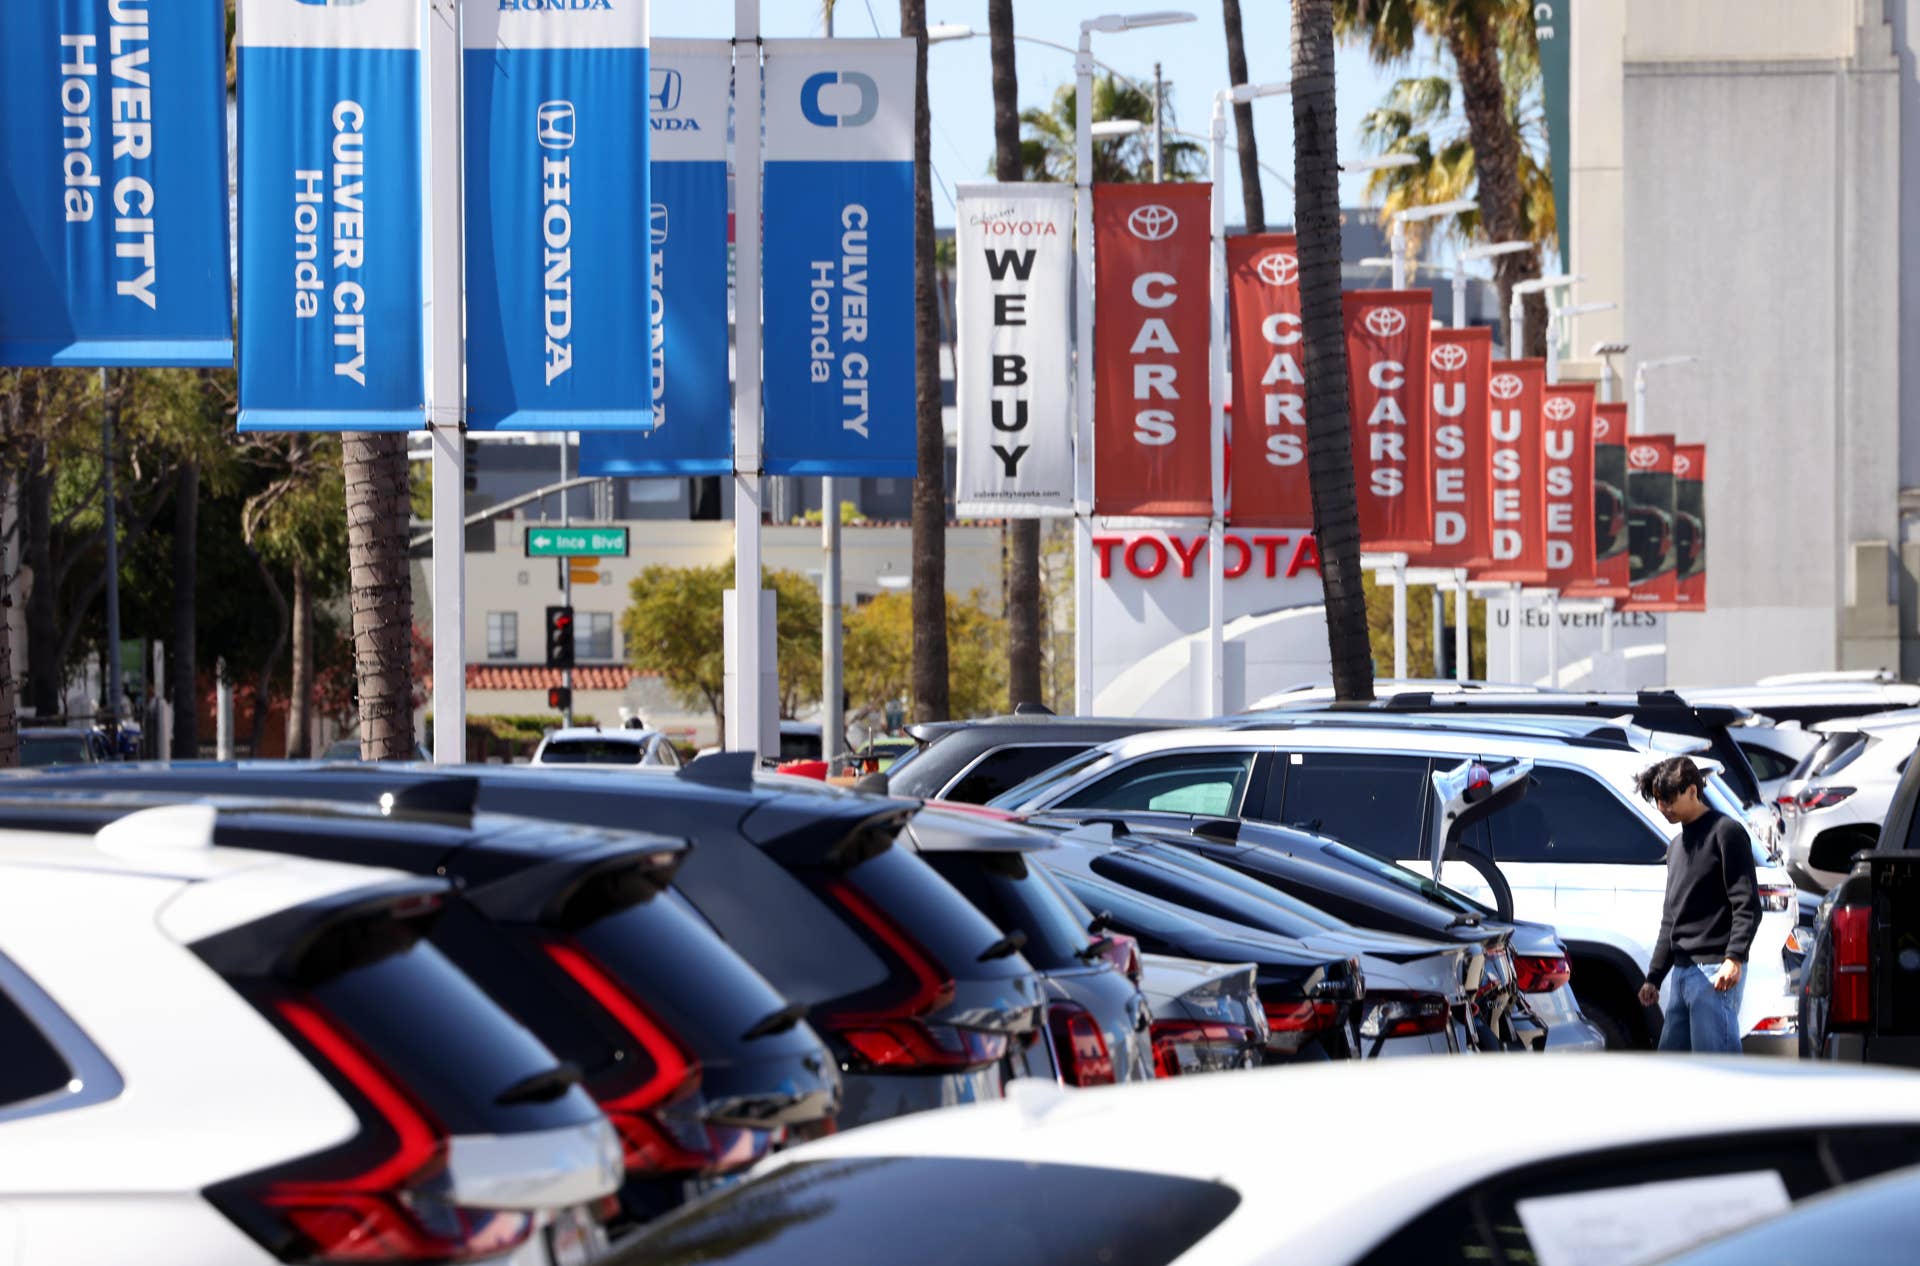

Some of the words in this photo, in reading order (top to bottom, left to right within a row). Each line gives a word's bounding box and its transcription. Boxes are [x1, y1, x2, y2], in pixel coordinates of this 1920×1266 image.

[60, 34, 101, 223] Honda
[108, 0, 152, 160] ULVER
[650, 118, 701, 131] NDA
[113, 177, 156, 310] CITY
[295, 170, 324, 319] Honda
[332, 100, 365, 269] CULVER
[981, 221, 1057, 236] TOYOTA
[333, 281, 366, 387] CITY
[542, 156, 573, 386] HONDA
[810, 261, 835, 384] Honda
[841, 203, 870, 343] CULVER
[984, 249, 1037, 327] WE
[841, 353, 870, 440] CITY
[990, 354, 1030, 479] BUY
[1129, 272, 1181, 446] CARS
[1261, 312, 1306, 466] CARS
[1367, 360, 1407, 496] CARS
[1432, 382, 1466, 545] USED
[1489, 410, 1522, 560] USED
[556, 535, 586, 549] Ince
[592, 533, 623, 549] Blvd
[1093, 535, 1322, 579] TOYOTA
[1544, 430, 1574, 569] USED
[1497, 608, 1550, 628] UED
[1558, 610, 1657, 628] VEHILES
